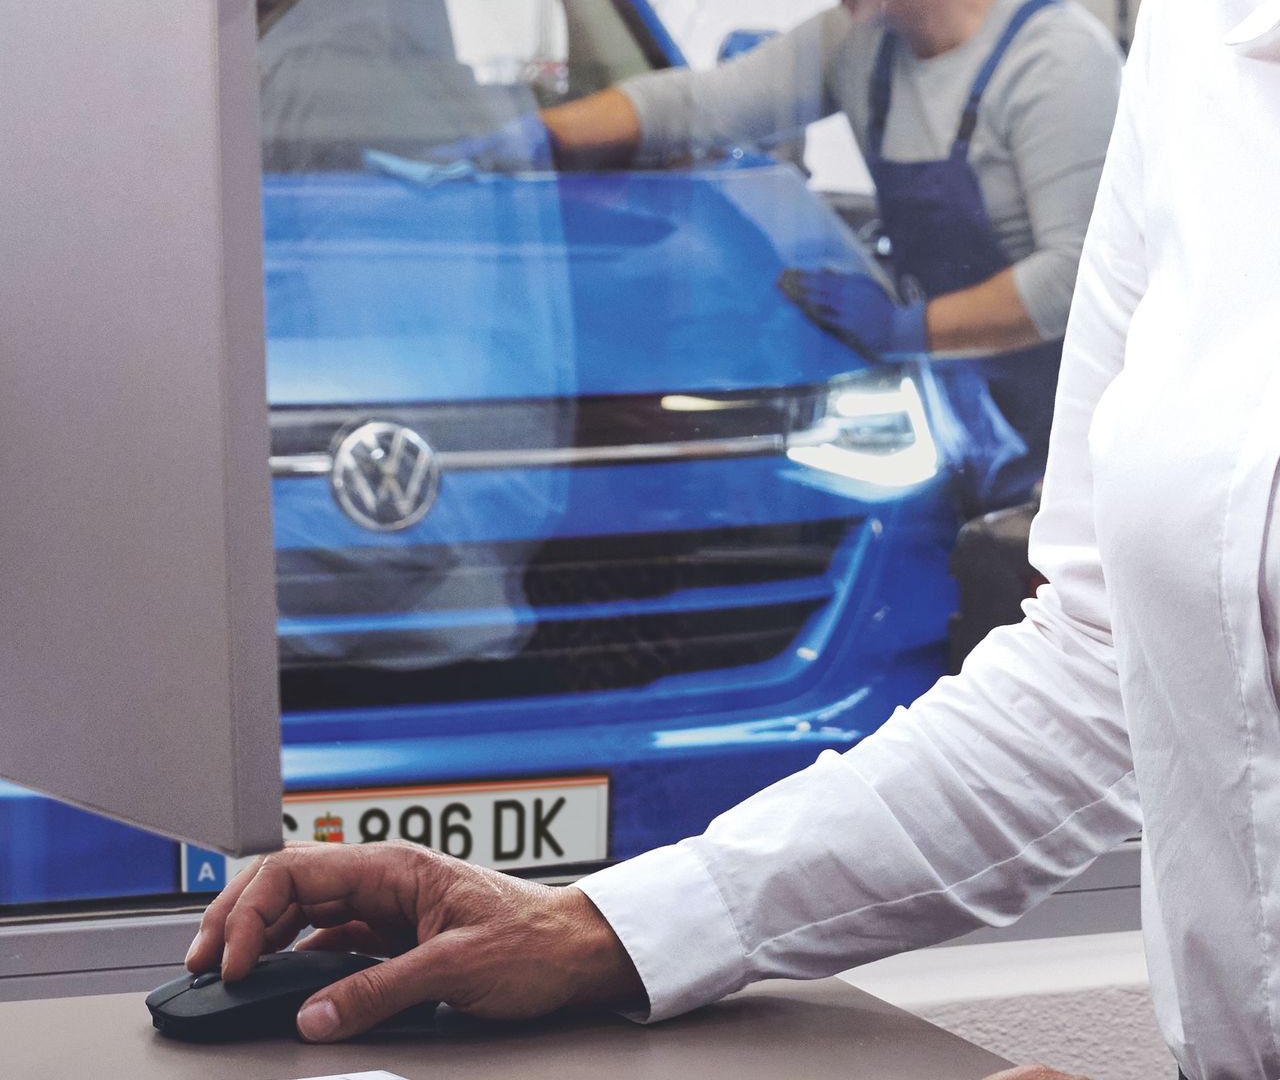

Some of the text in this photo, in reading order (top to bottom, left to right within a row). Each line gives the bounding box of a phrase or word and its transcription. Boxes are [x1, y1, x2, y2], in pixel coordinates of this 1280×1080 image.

[332, 421, 441, 531] VW
[359, 797, 566, 862] 896 DK
[197, 862, 216, 883] A
